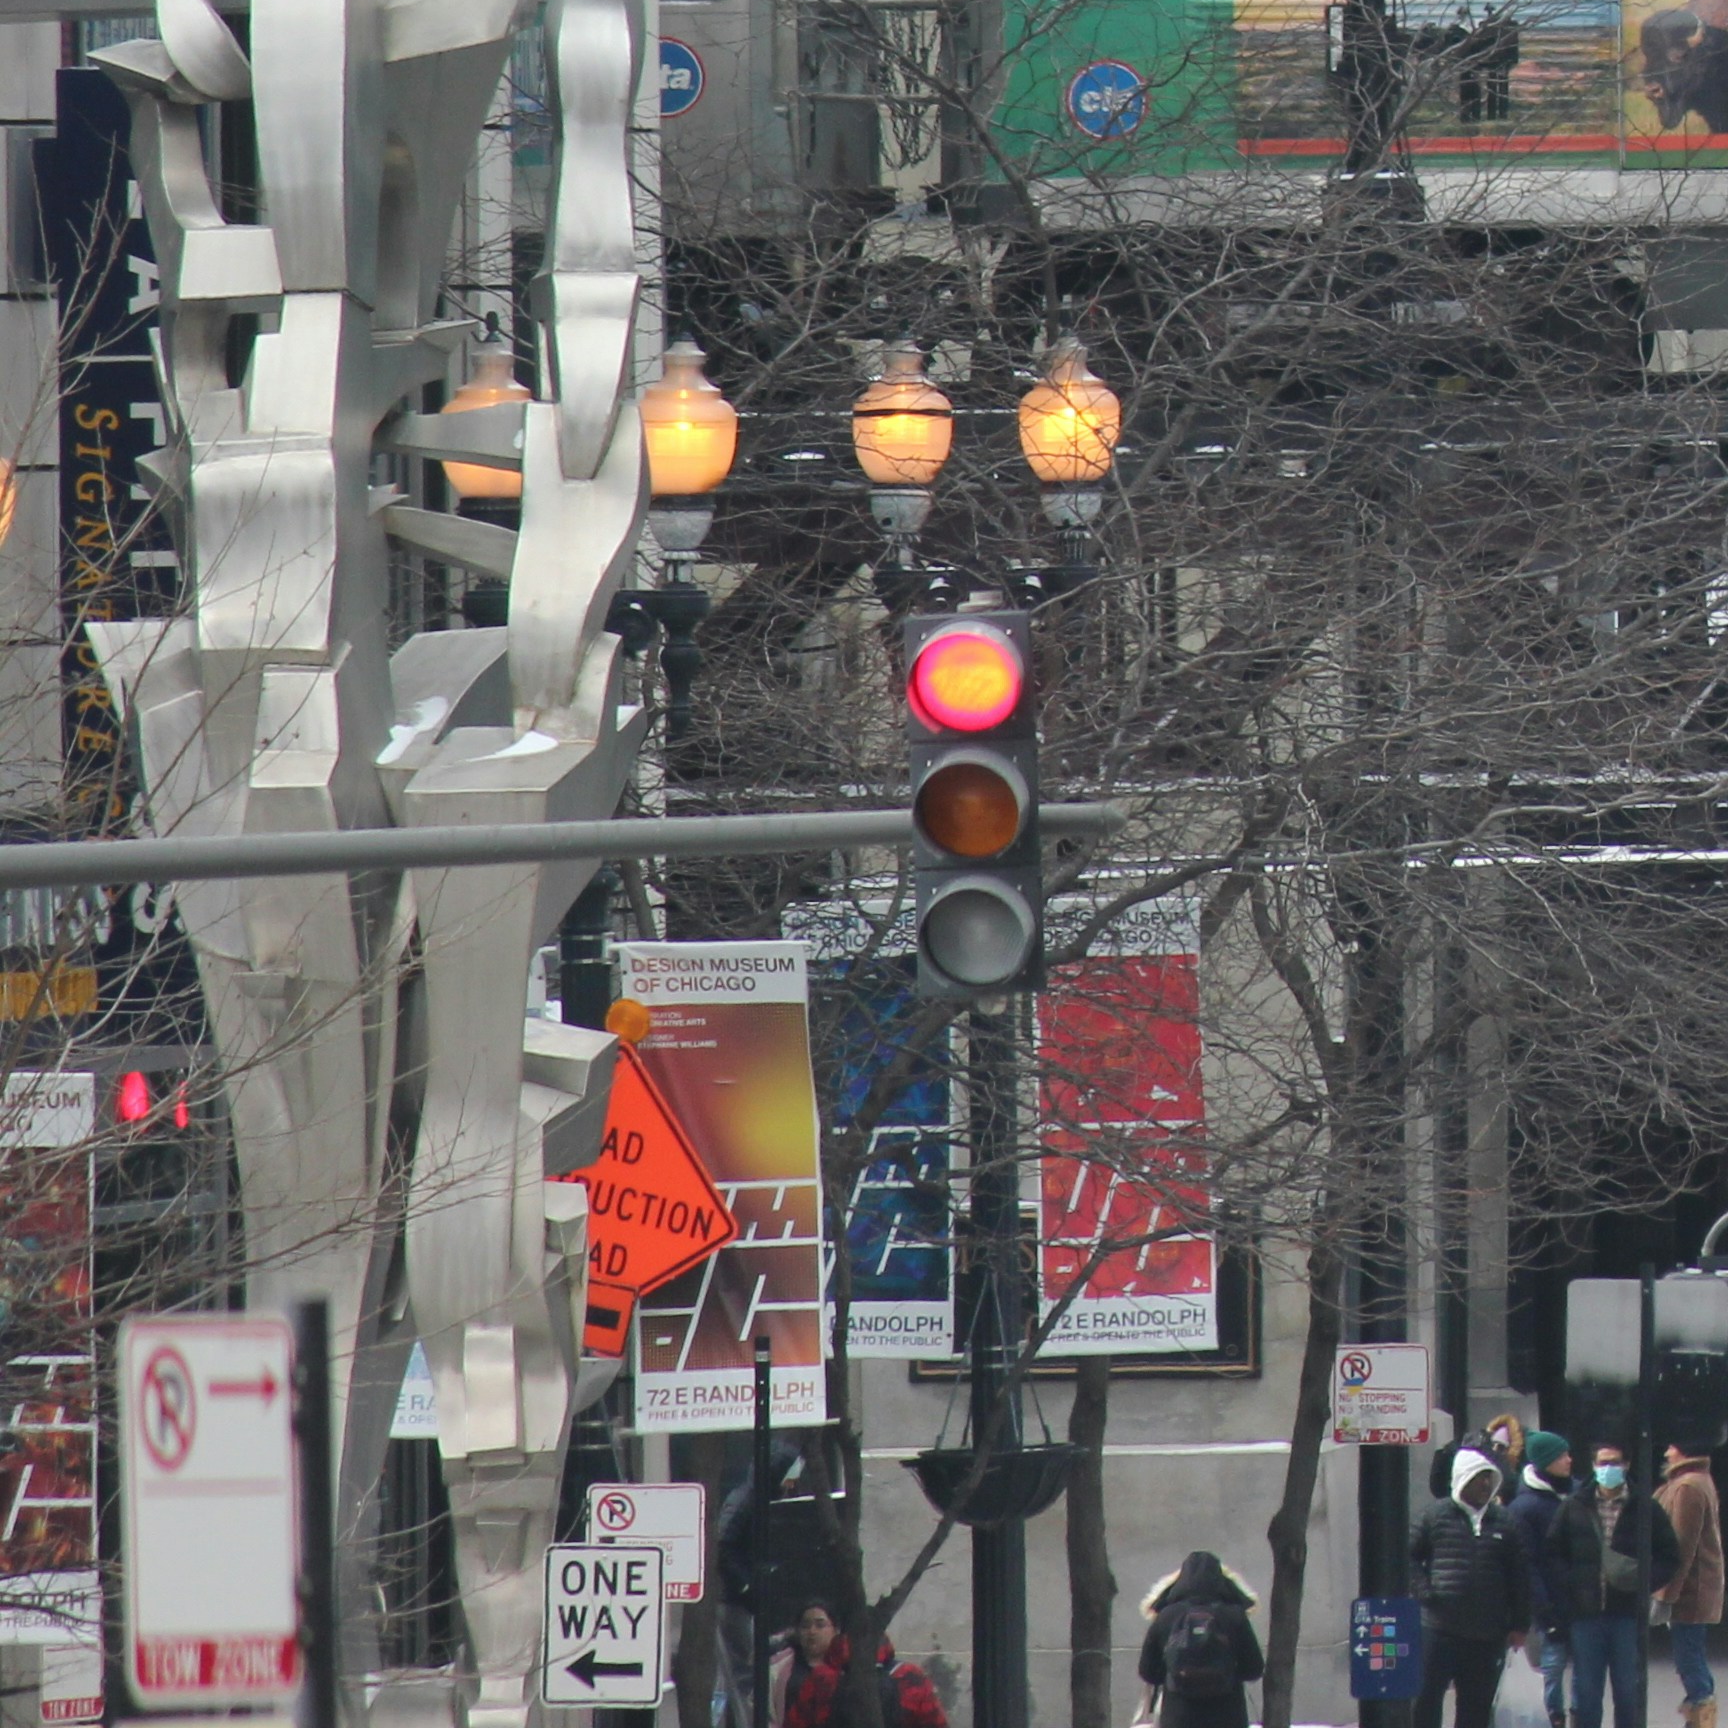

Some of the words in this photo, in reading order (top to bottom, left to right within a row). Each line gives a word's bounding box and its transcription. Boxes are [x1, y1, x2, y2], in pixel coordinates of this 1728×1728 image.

[631, 958, 704, 973] DESIGN
[710, 956, 795, 972] MUSEUM
[634, 978, 660, 994] OF
[666, 976, 756, 992] CHICAGO
[1076, 1313, 1089, 1327] E
[1093, 1308, 1206, 1328] RANDOLPH
[880, 1336, 900, 1346] THE
[902, 1336, 942, 1346] PUBLIC
[1166, 1327, 1206, 1338] PUBLIC
[647, 1389, 670, 1406] 72
[676, 1388, 688, 1404] E
[693, 1381, 815, 1403] RANDLPH
[1359, 1393, 1407, 1403] STOPPING
[648, 1410, 679, 1420] FREE
[691, 1406, 724, 1418] OPEN
[727, 1406, 744, 1417] TO
[769, 1401, 815, 1414] PUBLIC
[1359, 1404, 1408, 1414] STANDING
[561, 1560, 648, 1596] ONE
[557, 1604, 648, 1640] WAY
[1373, 1615, 1397, 1623] Trains
